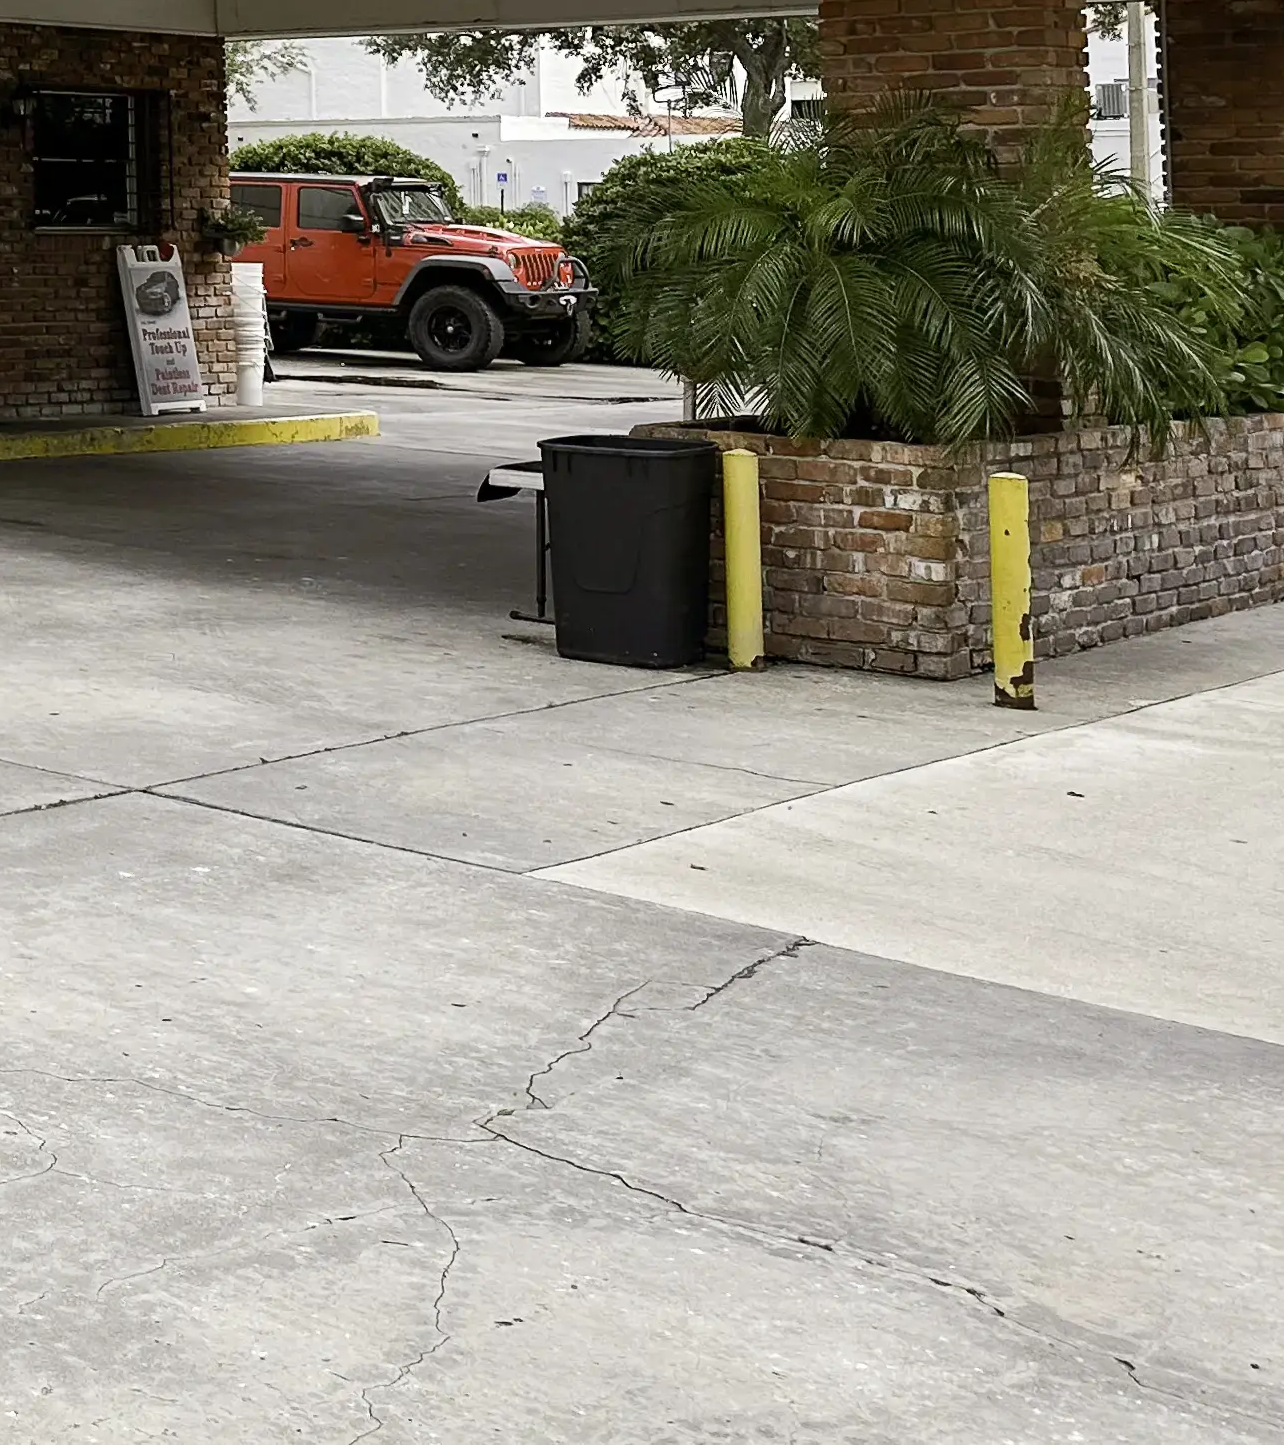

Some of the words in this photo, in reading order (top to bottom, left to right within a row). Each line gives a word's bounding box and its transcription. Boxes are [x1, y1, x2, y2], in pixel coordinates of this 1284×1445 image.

[142, 327, 190, 341] Professional
[149, 343, 174, 355] Touch
[175, 342, 188, 356] Up
[150, 383, 173, 396] Dent
[173, 381, 199, 397] Repair
